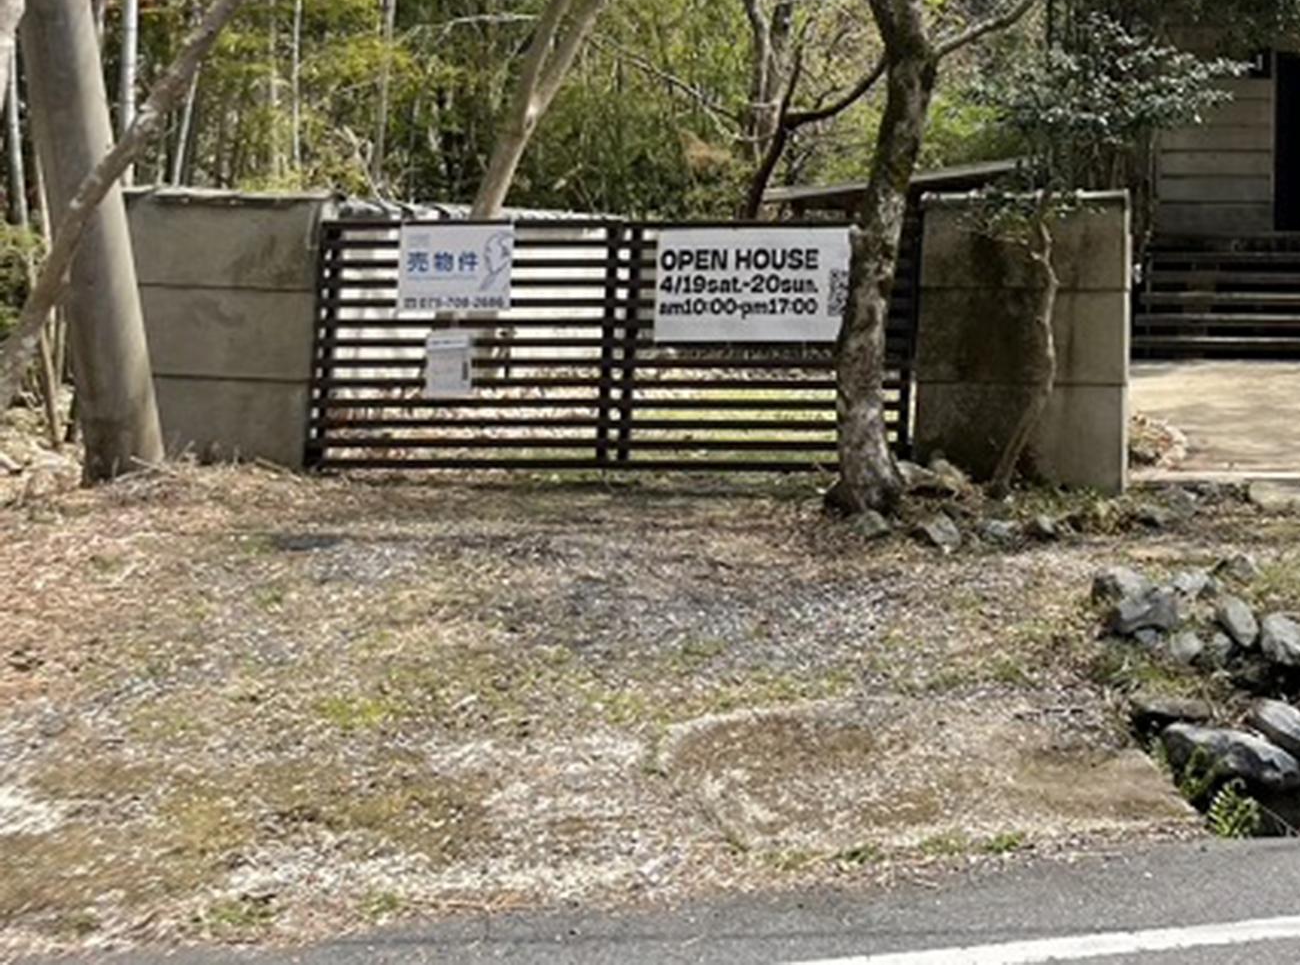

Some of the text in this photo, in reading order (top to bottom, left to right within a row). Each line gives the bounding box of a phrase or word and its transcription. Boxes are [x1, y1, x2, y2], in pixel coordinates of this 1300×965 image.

[407, 251, 478, 273] 売物件
[660, 248, 819, 271] OPEN HOUSE
